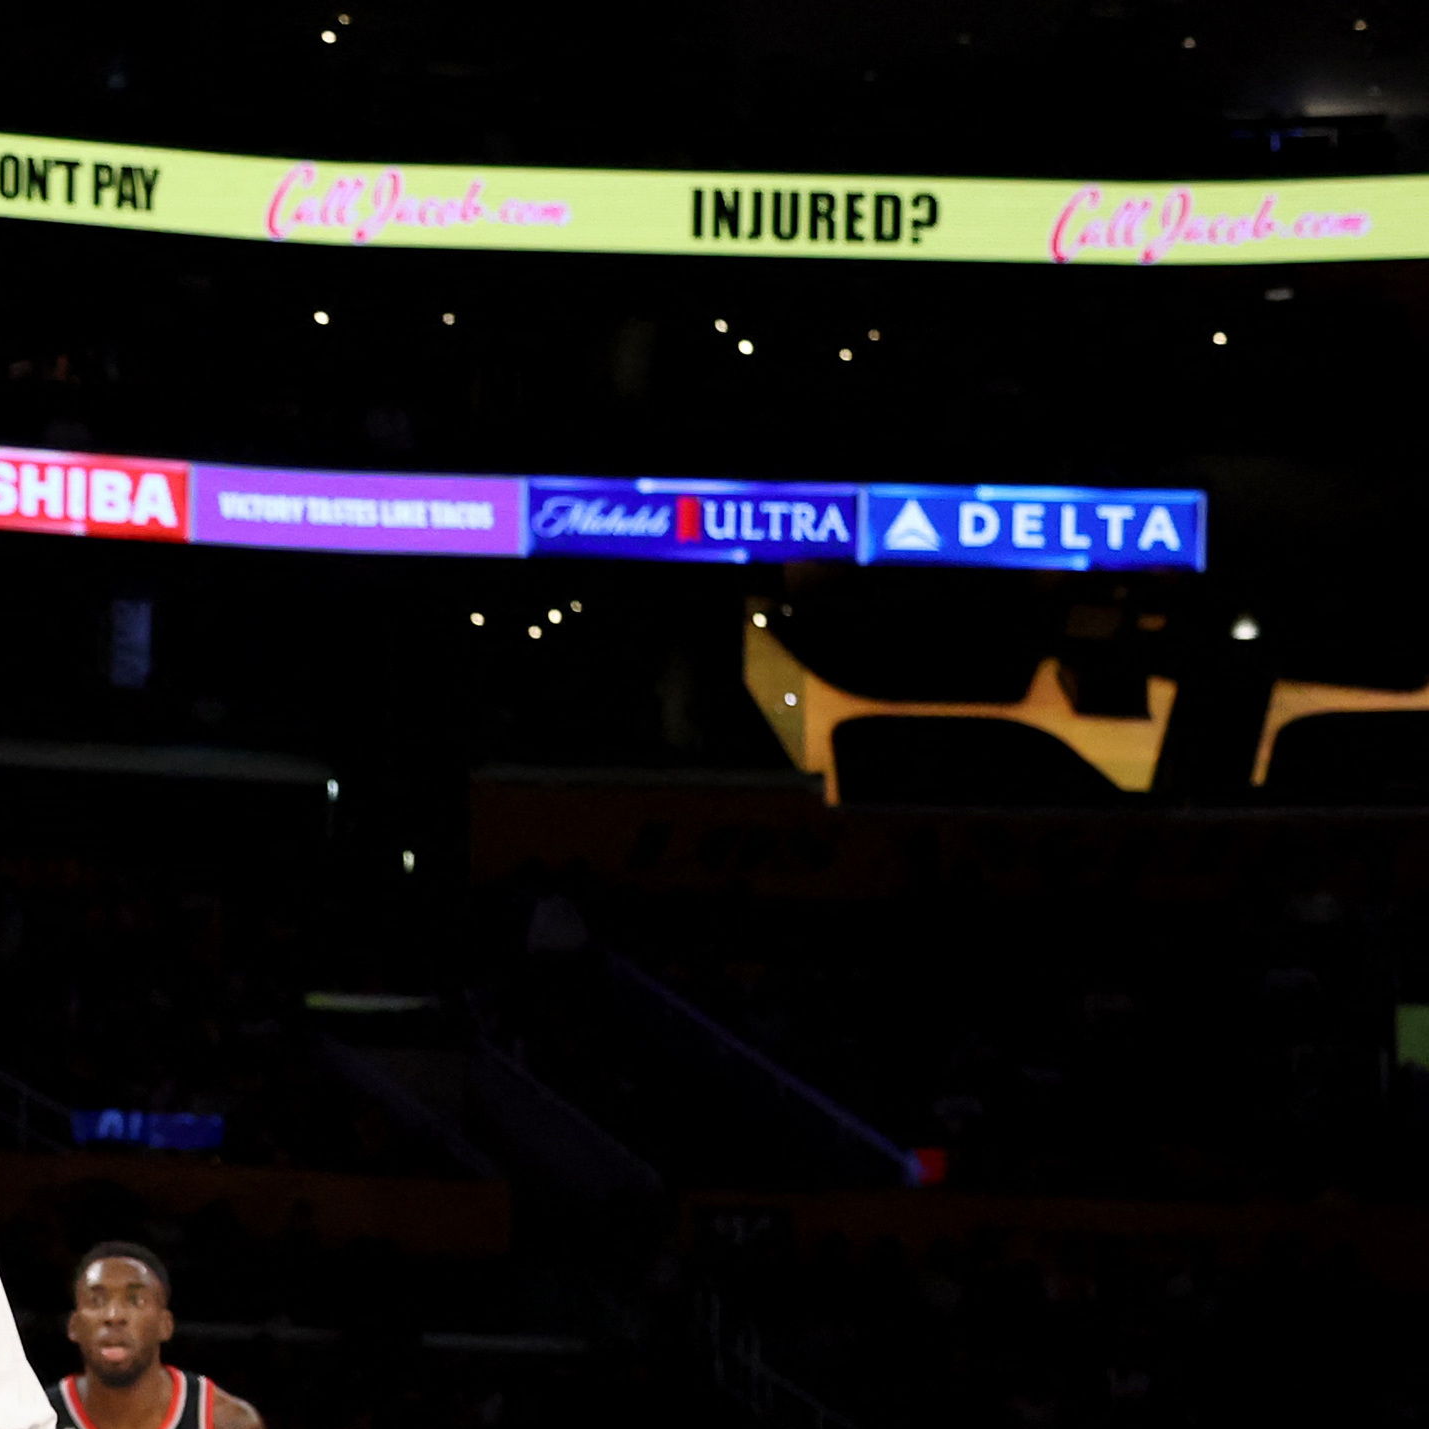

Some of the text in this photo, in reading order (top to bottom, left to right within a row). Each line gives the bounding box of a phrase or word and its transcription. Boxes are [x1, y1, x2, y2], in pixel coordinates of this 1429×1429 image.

[91, 162, 162, 212] PAY
[691, 186, 941, 246] INJURED?
[702, 499, 851, 543] ULTRA
[956, 501, 1182, 553] DELTA
